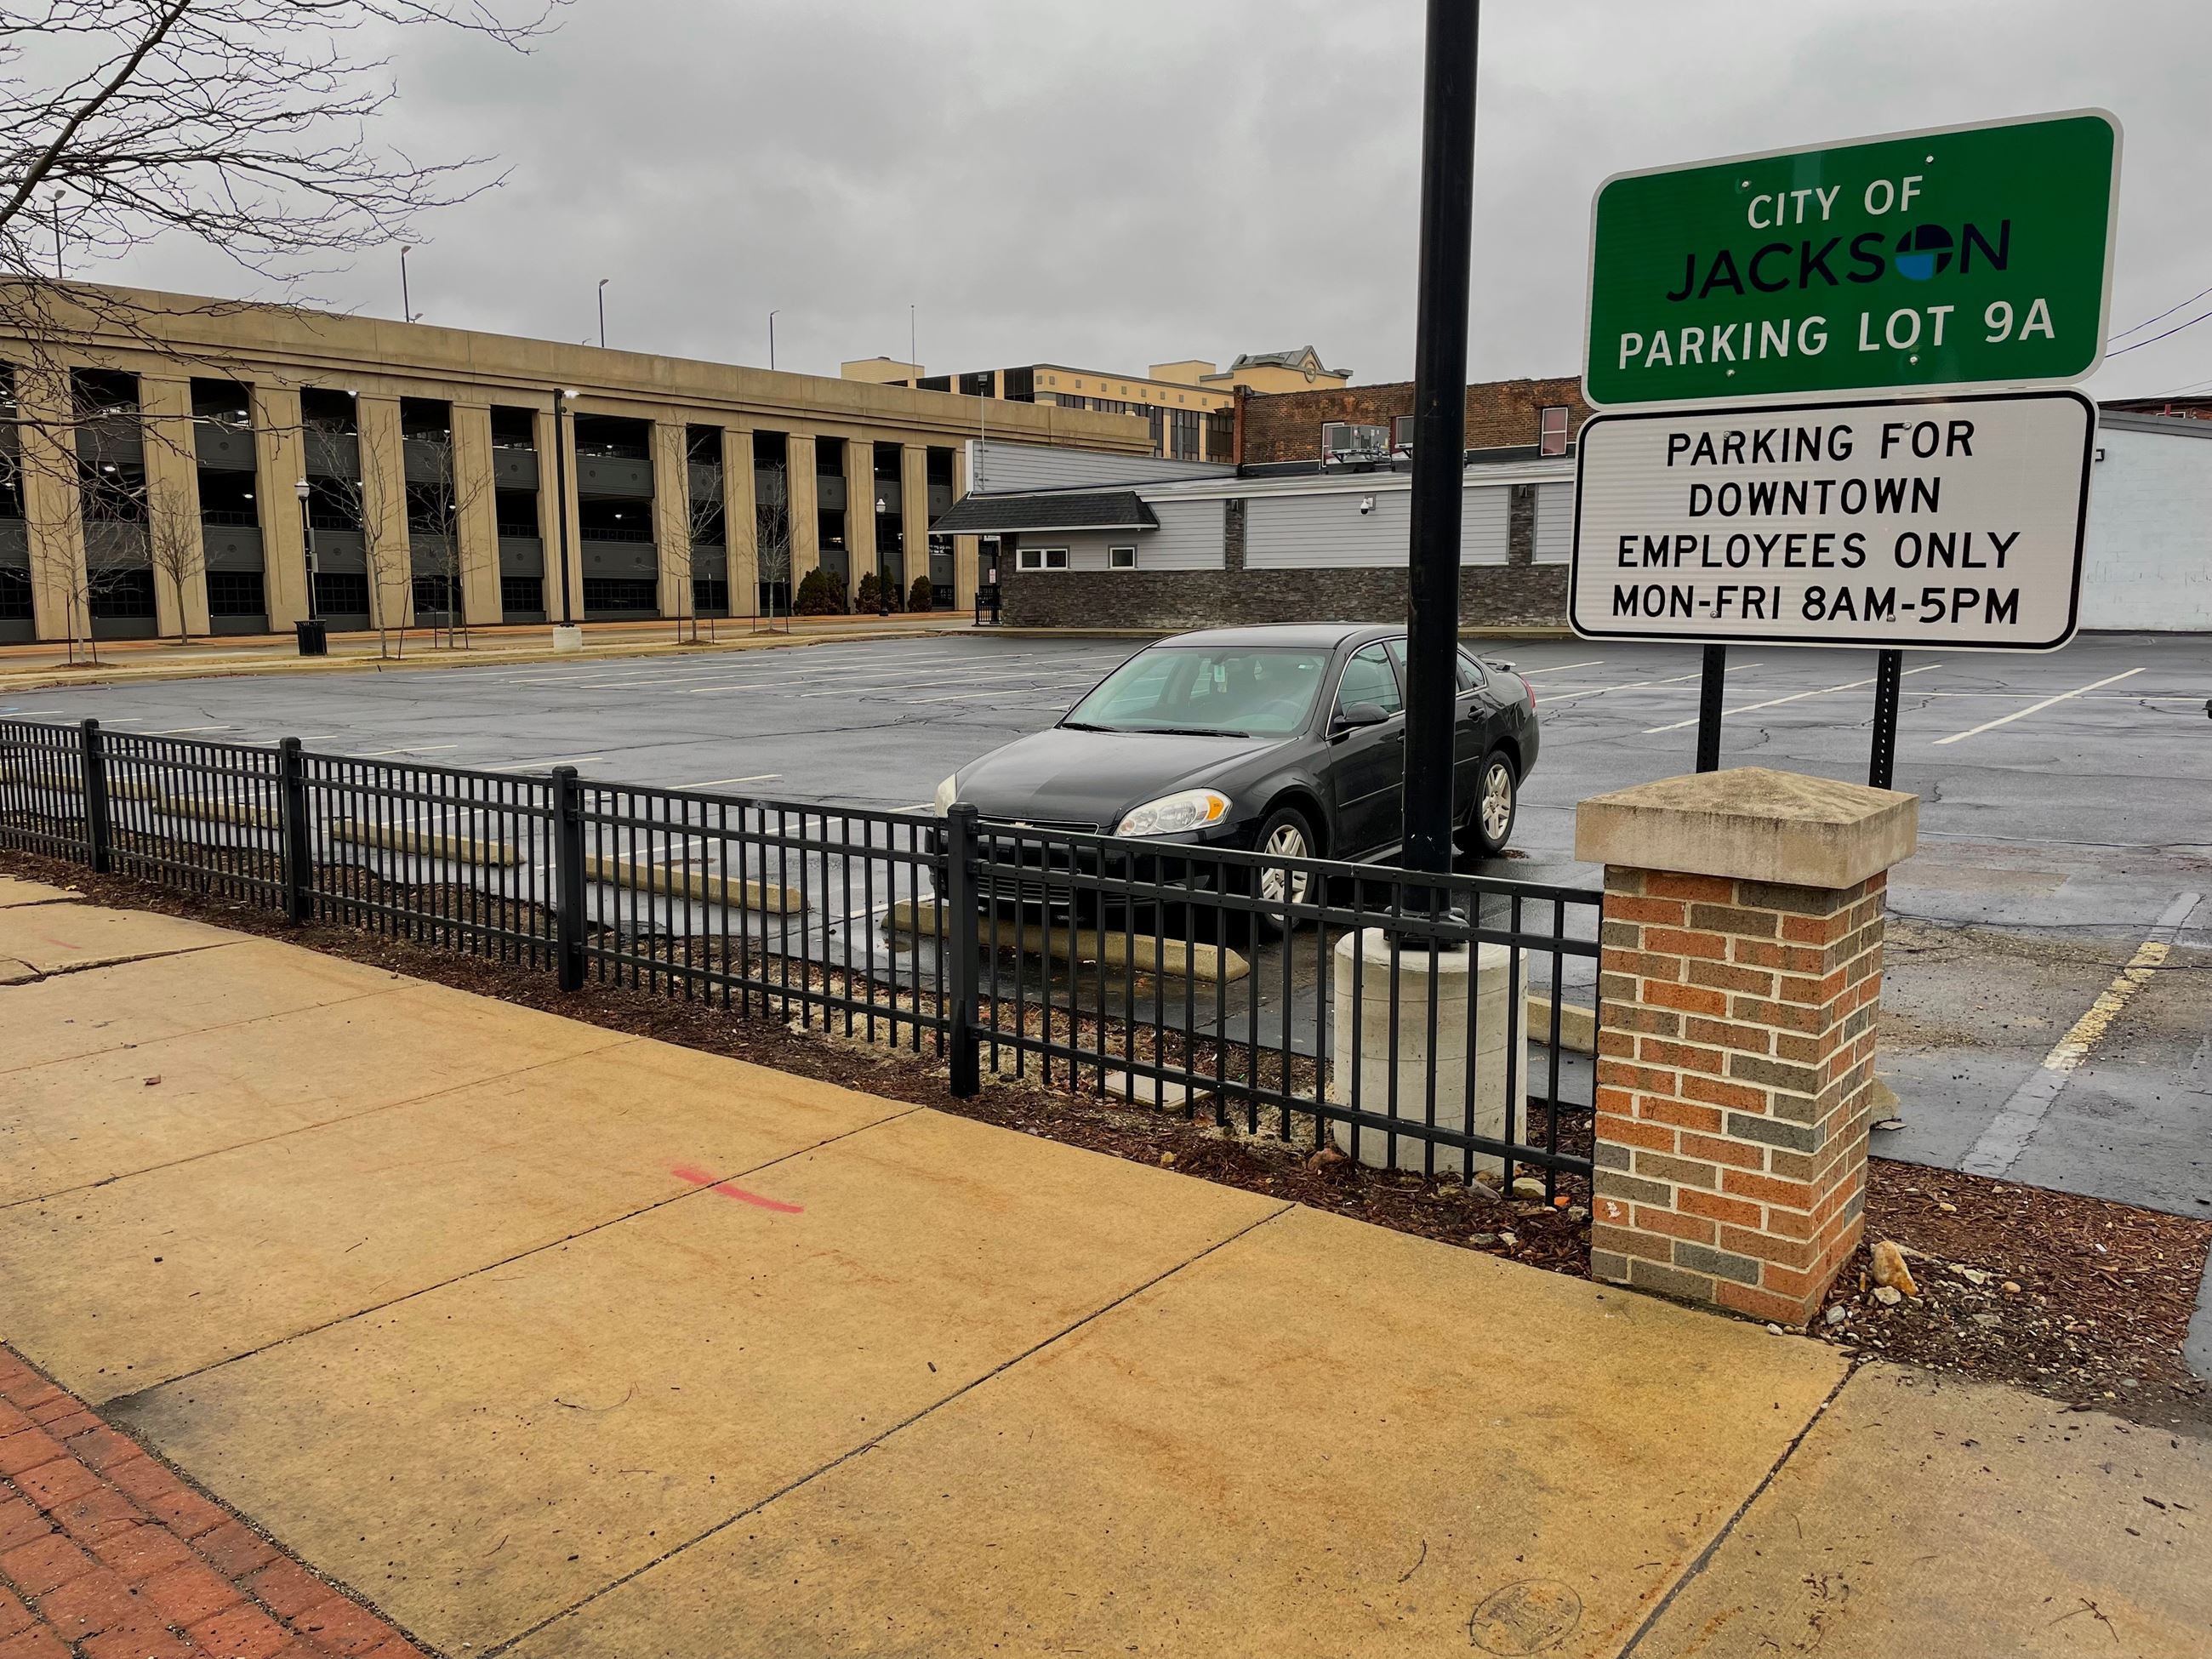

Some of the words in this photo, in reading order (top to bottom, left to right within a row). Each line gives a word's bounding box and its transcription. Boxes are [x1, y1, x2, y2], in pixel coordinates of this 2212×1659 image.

[1748, 185, 1840, 229] CITY
[1865, 175, 1923, 216] OF
[1666, 219, 2011, 302] JACKSON
[1619, 316, 1827, 369] PARKING
[1859, 305, 1954, 351] LOT
[1985, 298, 2055, 343] 9A
[1667, 424, 1853, 467] PARKING
[1880, 419, 1975, 460] FOR
[1688, 476, 1941, 517] DOWNTOWN
[1617, 532, 1867, 568] EMPLOYEES
[1894, 531, 2021, 569] ONLY
[1612, 584, 1781, 621] MON-FRI
[1802, 584, 2020, 624] 8AM-5PM
